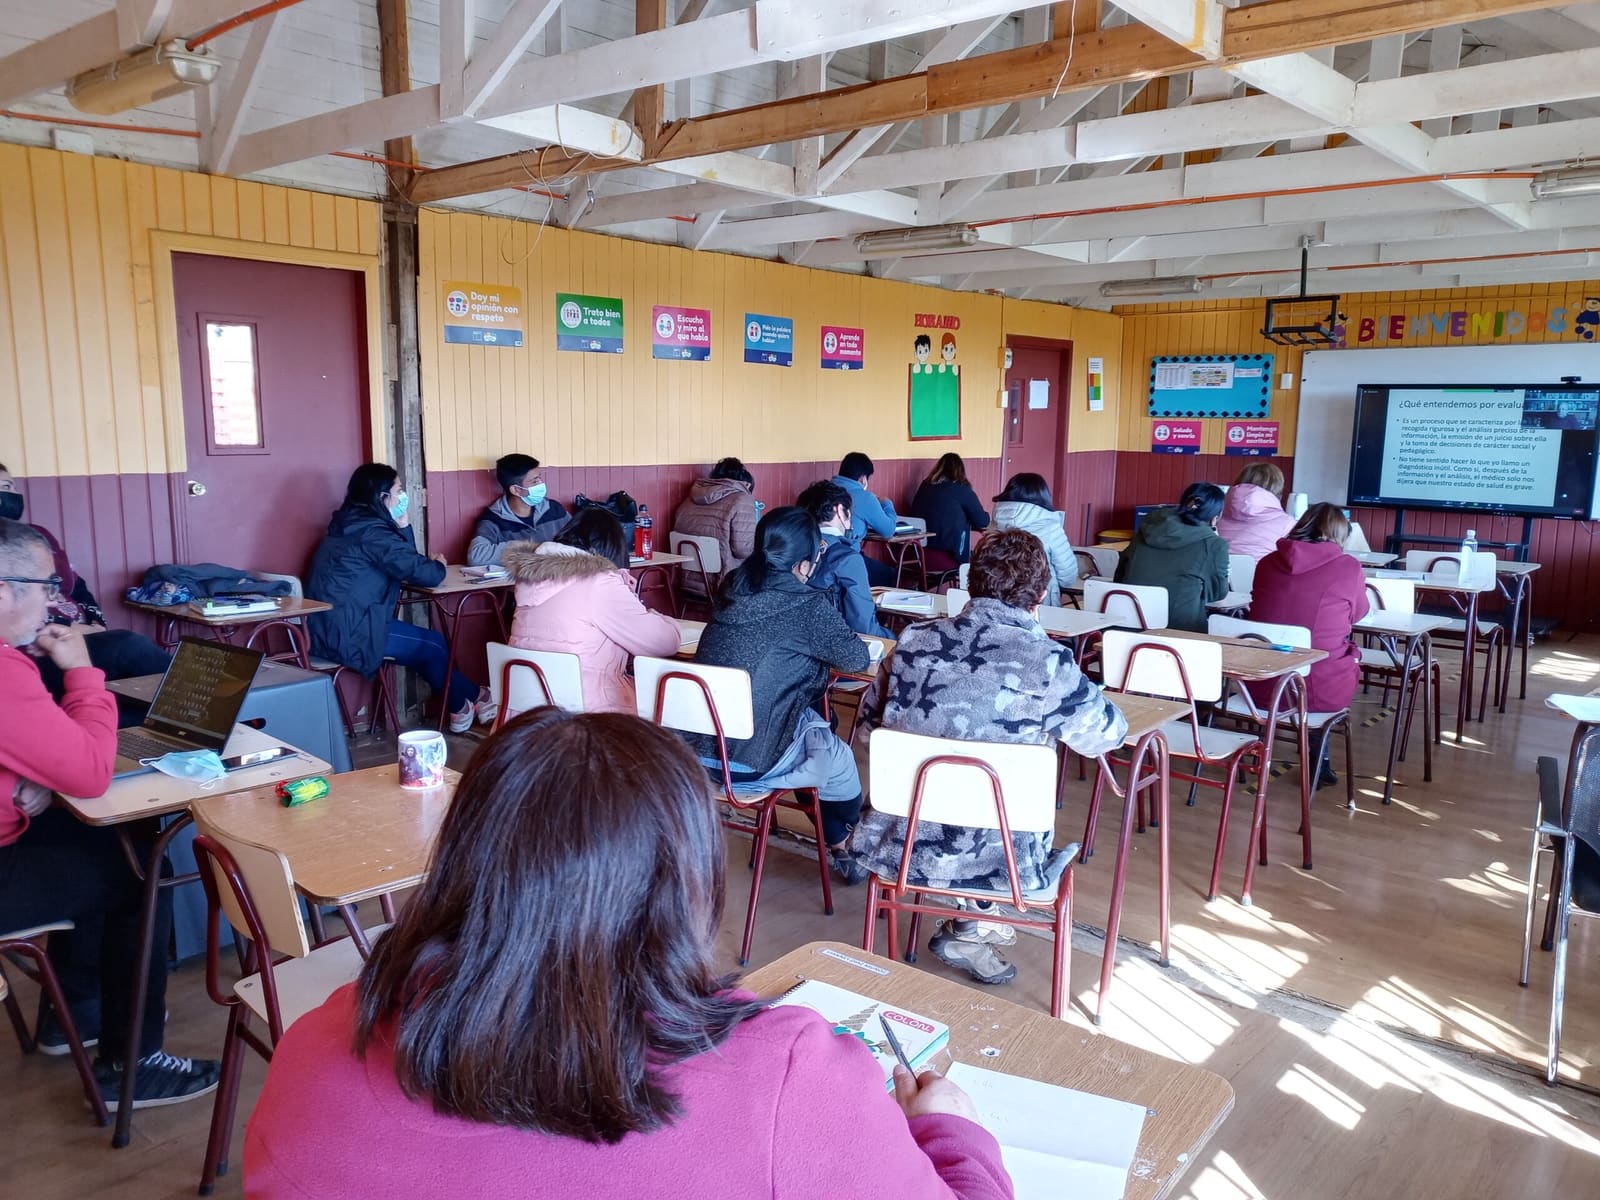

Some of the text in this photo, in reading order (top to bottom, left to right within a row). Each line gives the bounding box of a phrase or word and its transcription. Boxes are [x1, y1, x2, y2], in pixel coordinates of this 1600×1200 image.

[490, 293, 500, 303] mi
[471, 303, 502, 312] opinión
[472, 313, 504, 323] respeto
[583, 307, 621, 319] Trato bien
[590, 317, 611, 326] todos
[678, 314, 703, 324] Escucho
[678, 325, 682, 333] y
[683, 324, 698, 332] miro
[1358, 307, 1568, 342] BIENVENIDOS
[678, 332, 709, 342] que habla
[1399, 400, 1422, 409] ¿Qué
[1423, 400, 1478, 409] entendemos
[1479, 401, 1495, 409] por
[1247, 431, 1265, 439] limpio
